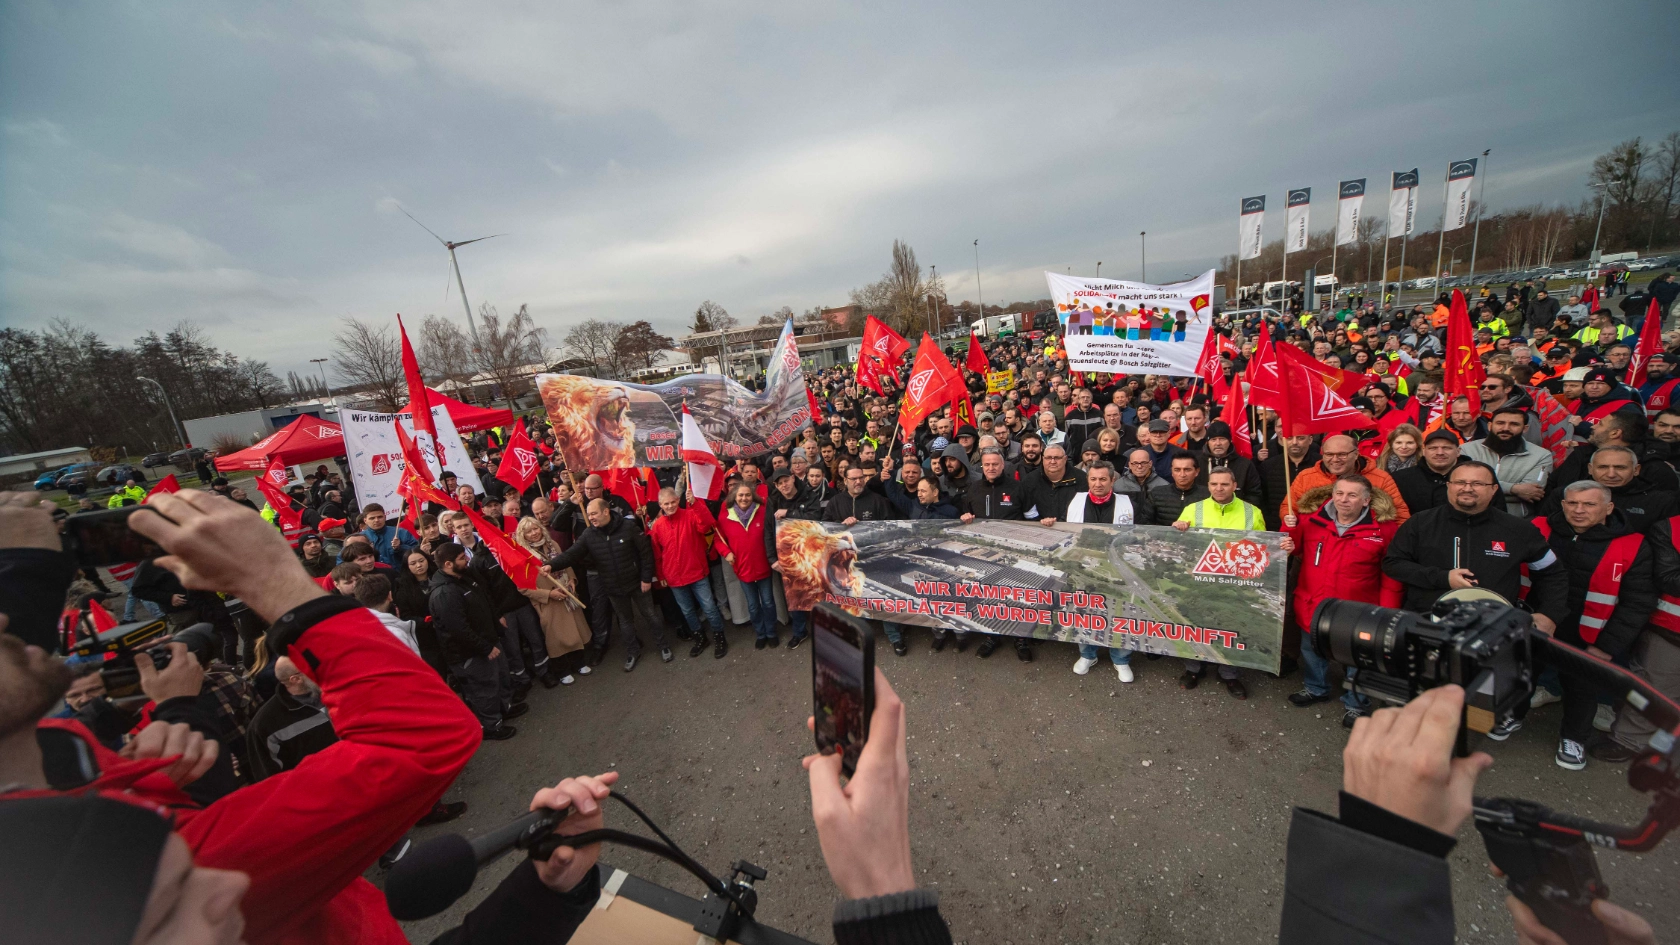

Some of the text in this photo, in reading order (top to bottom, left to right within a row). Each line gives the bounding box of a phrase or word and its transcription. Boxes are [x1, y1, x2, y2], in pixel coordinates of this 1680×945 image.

[1074, 290, 1116, 299] SOLIDAT
[352, 413, 366, 422] Wir
[650, 432, 677, 440] BOSCH
[645, 444, 675, 462] WIR
[722, 440, 740, 456] FÜR
[1218, 577, 1264, 587] Salzgitter
[914, 580, 1106, 610] WIR KÄMPFEN FÜR
[826, 592, 1246, 650] ARBEITSPLÄTZE, WÜRDE UND ZUKUNFT.
